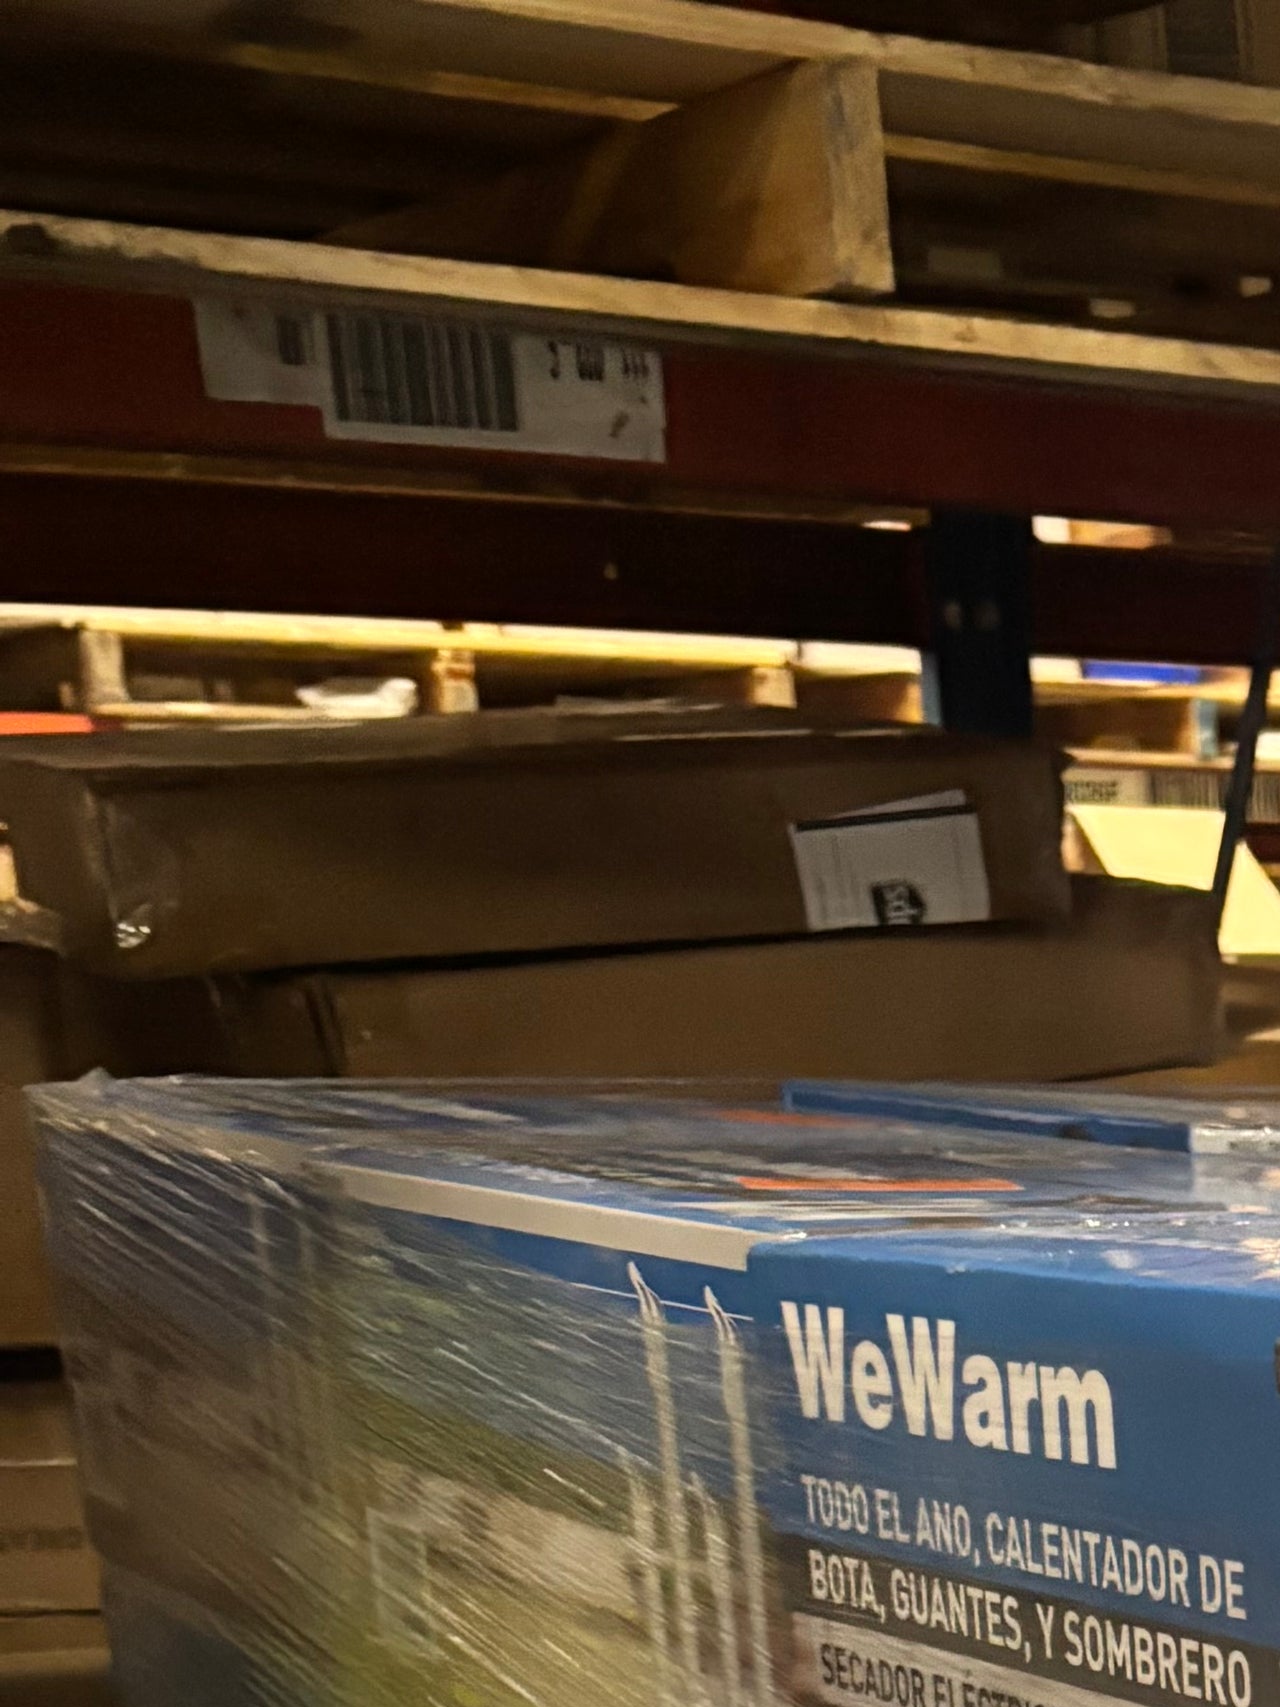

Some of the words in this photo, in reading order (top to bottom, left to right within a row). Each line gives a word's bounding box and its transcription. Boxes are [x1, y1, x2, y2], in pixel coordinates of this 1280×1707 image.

[781, 1301, 1117, 1470] WeWarm
[801, 1474, 868, 1536] TODO
[875, 1488, 911, 1544] EL
[985, 1513, 1191, 1608] CALENTADOR
[1199, 1554, 1249, 1621] DE
[808, 1550, 887, 1625] BOTA,
[890, 1569, 1032, 1663] GUANTES,
[1034, 1602, 1056, 1660] Y
